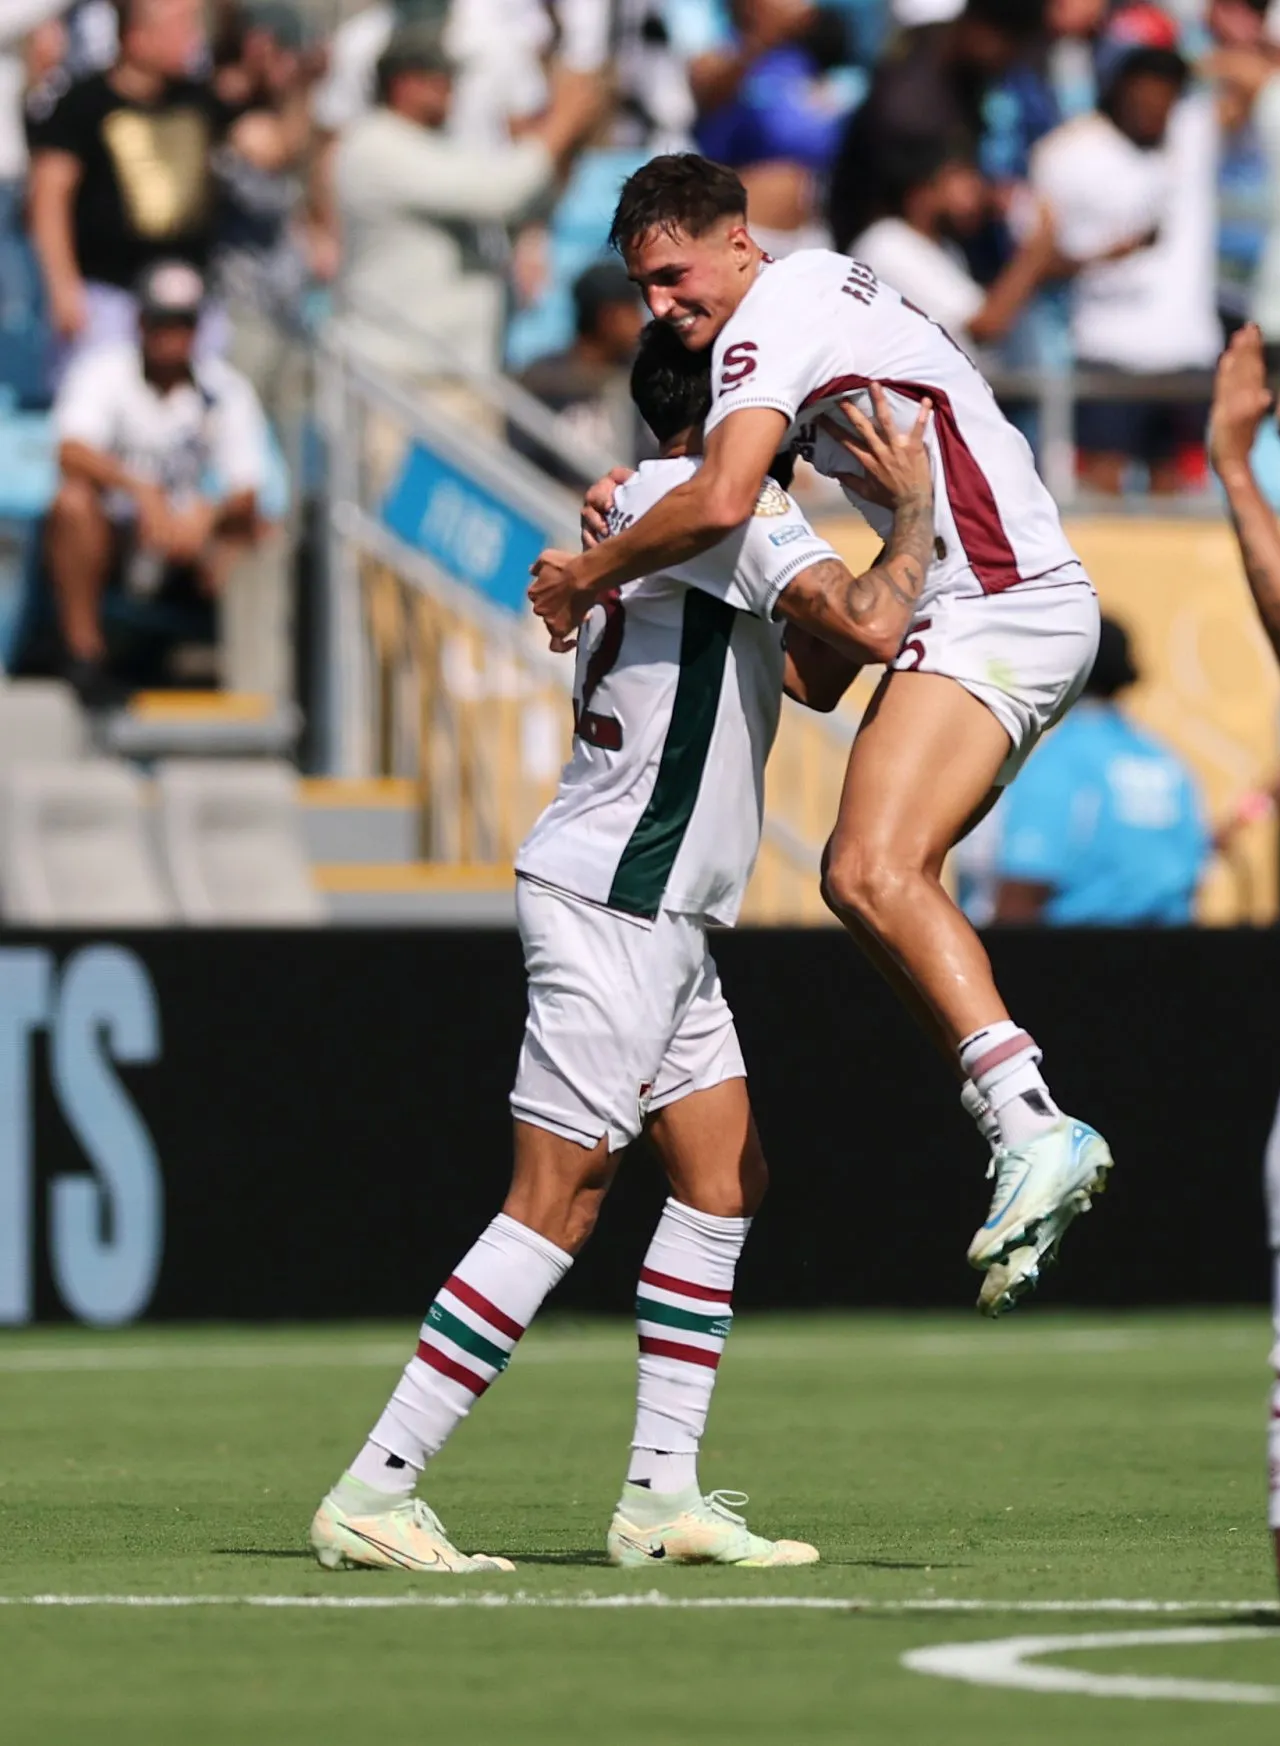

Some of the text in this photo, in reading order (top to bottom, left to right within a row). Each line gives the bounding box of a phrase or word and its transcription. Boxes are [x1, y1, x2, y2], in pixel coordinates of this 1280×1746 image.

[572, 587, 626, 752] 2
[896, 619, 932, 671] 5
[0, 941, 164, 1329] TS
